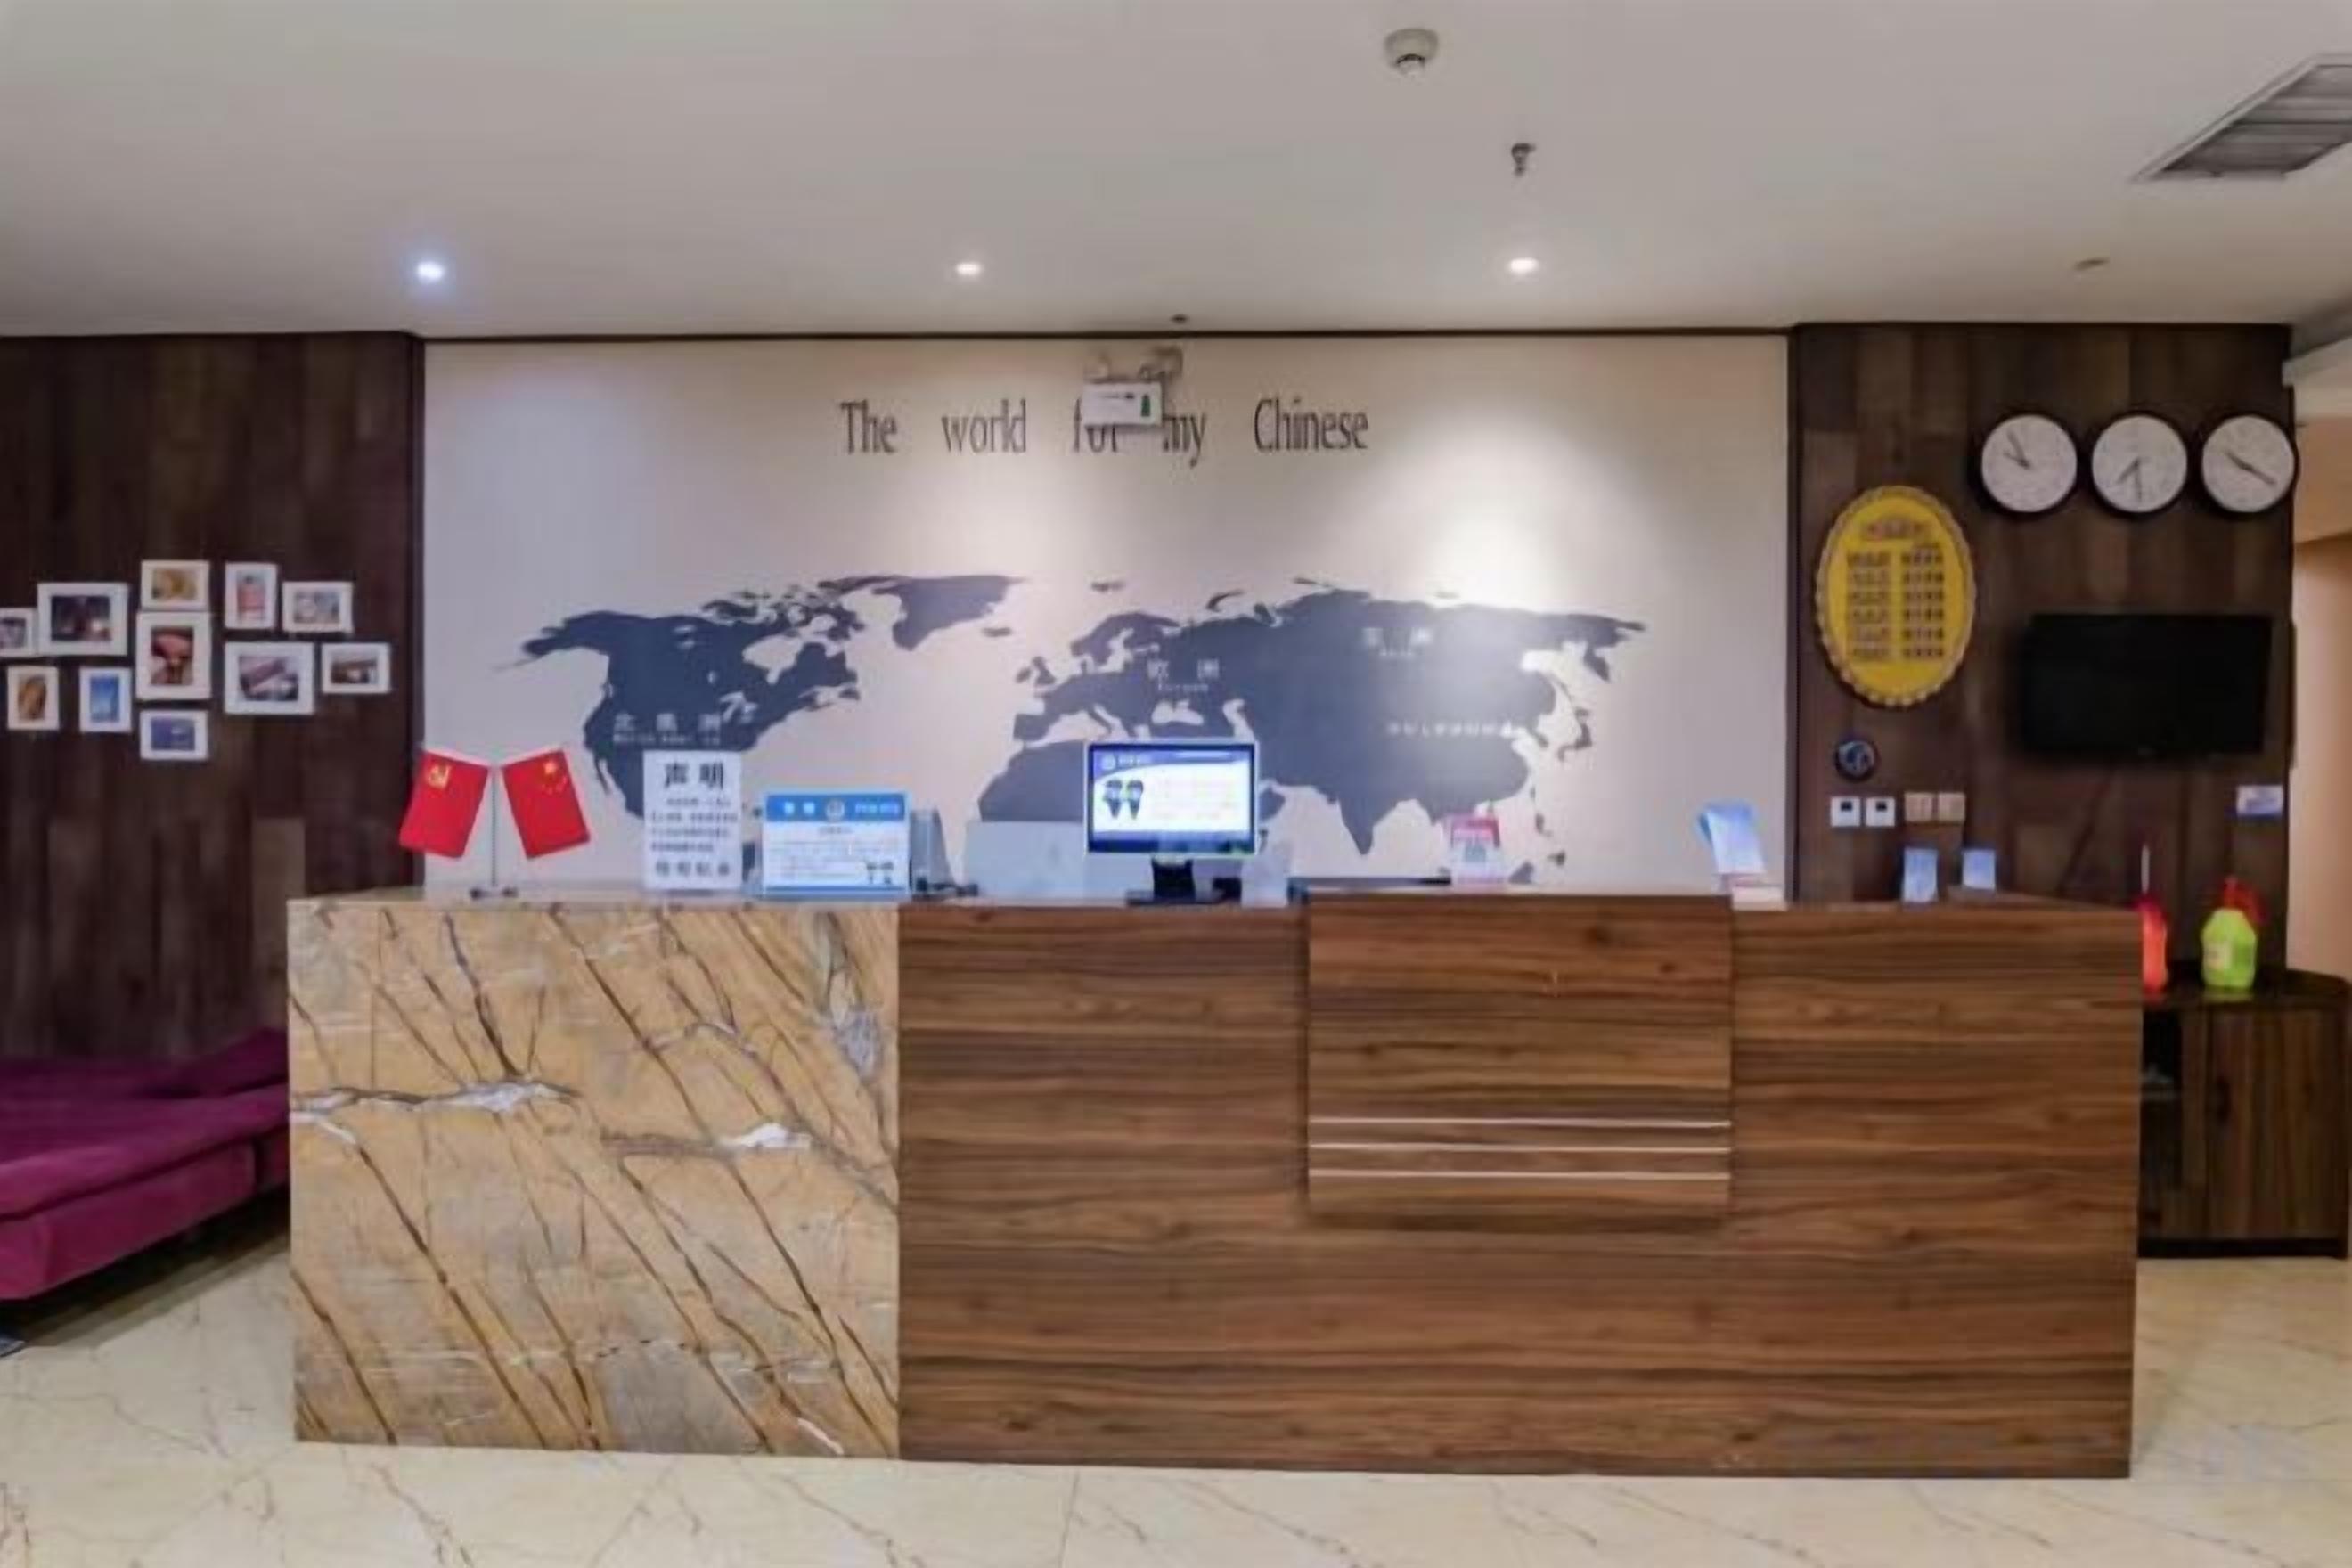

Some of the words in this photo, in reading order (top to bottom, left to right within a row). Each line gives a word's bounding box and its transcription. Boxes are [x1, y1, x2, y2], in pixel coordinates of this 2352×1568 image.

[840, 399, 898, 454] The
[942, 398, 1027, 454] world
[1254, 396, 1370, 453] Chinese
